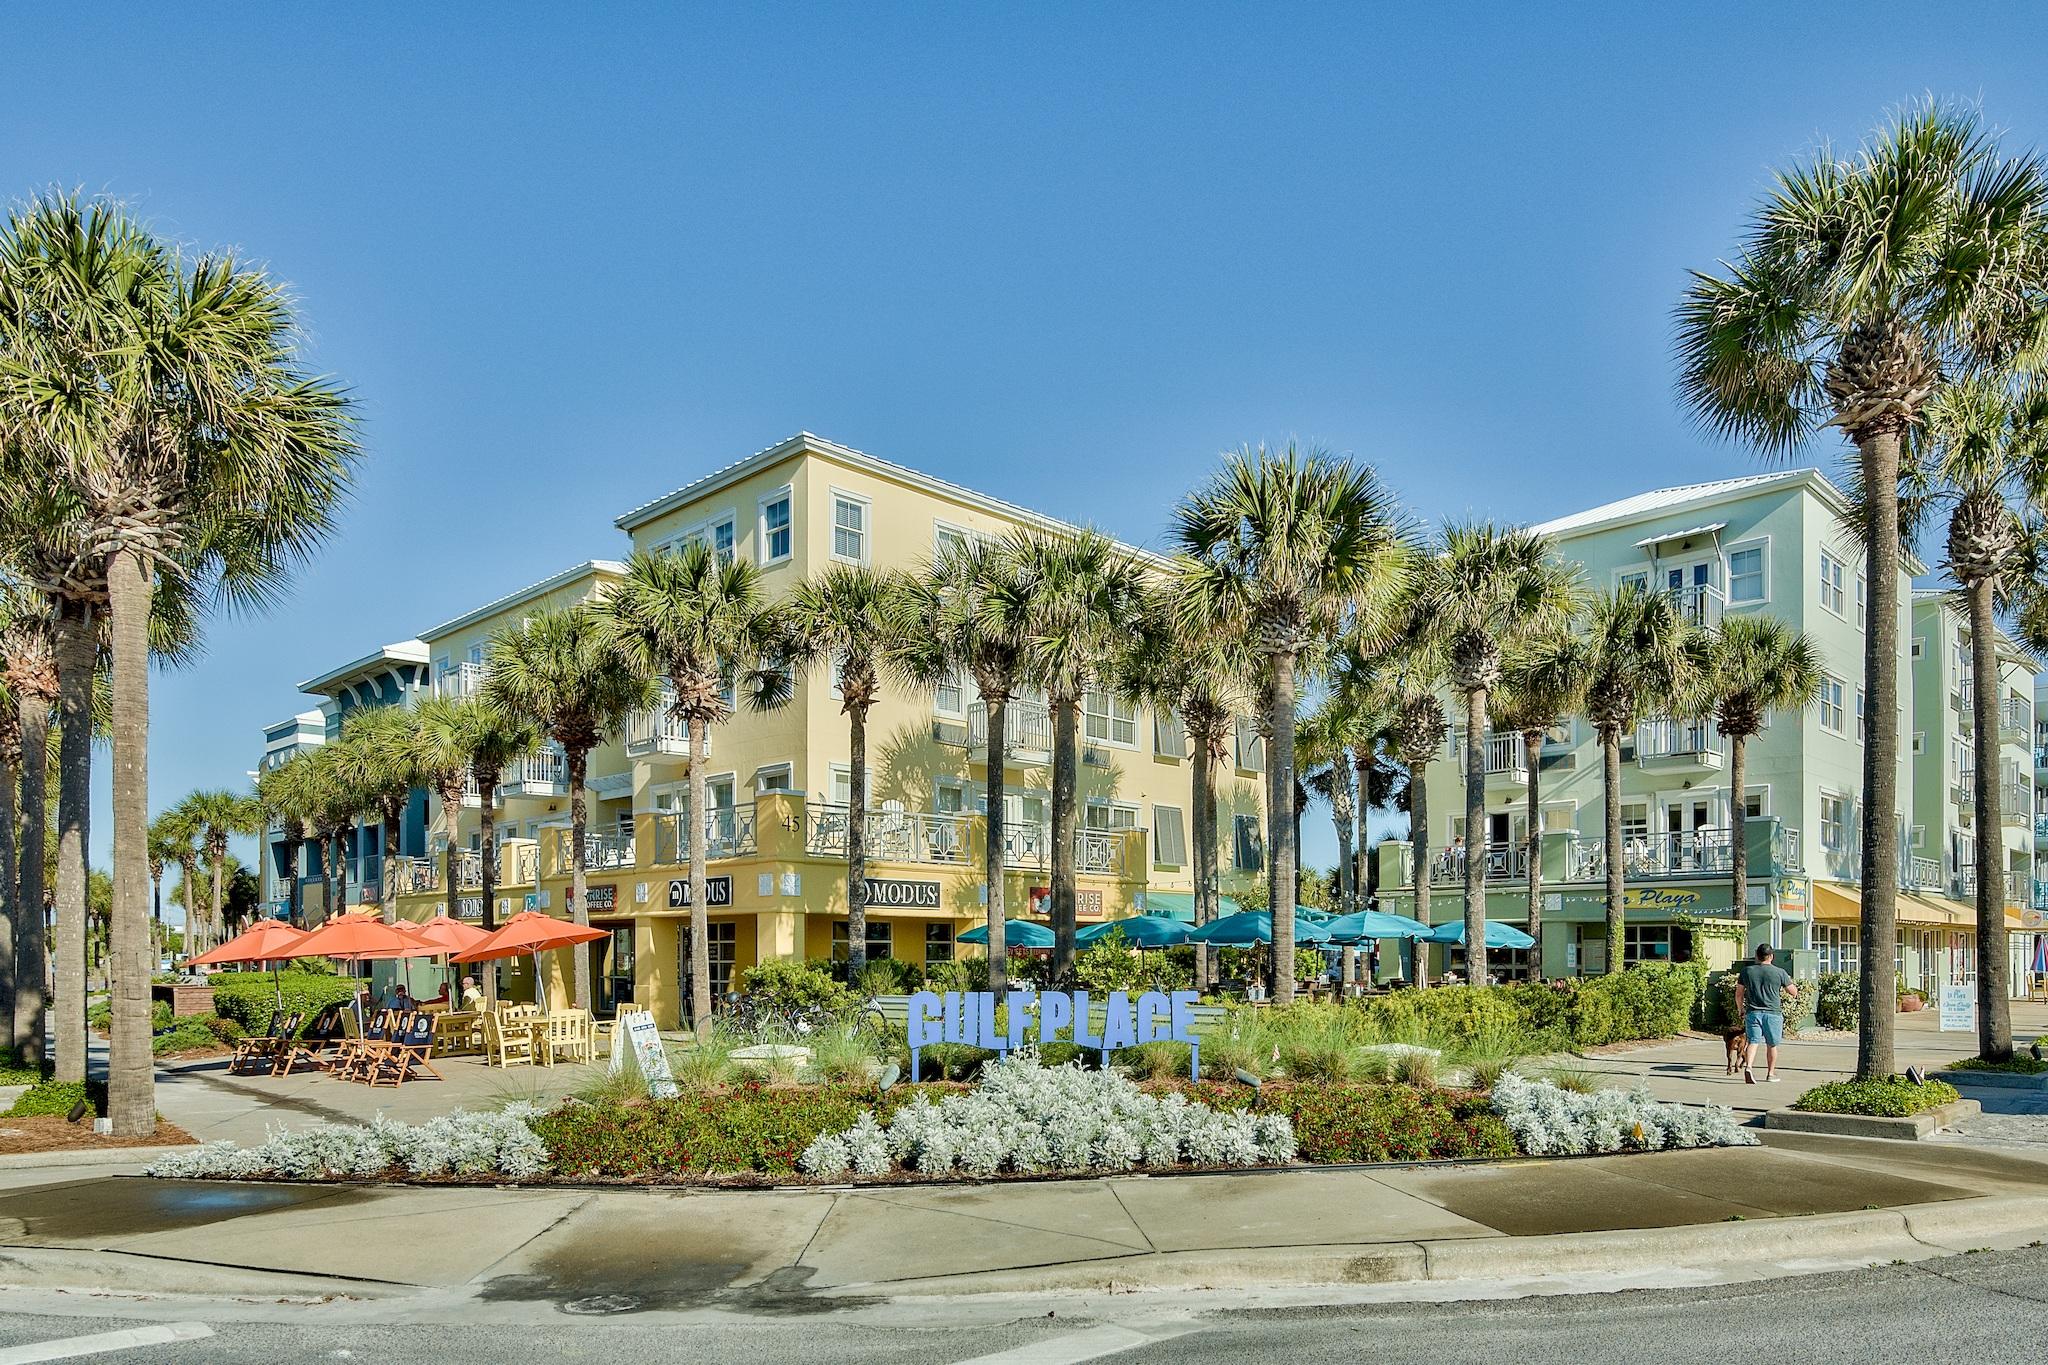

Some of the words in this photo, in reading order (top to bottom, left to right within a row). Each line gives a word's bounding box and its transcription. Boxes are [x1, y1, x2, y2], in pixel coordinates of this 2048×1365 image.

[781, 815, 800, 832] 45
[683, 881, 726, 904] MUS
[873, 882, 936, 905] MODUS
[1077, 893, 1101, 905] RISE
[1640, 888, 1697, 907] Playa
[587, 900, 603, 909] OFFEE
